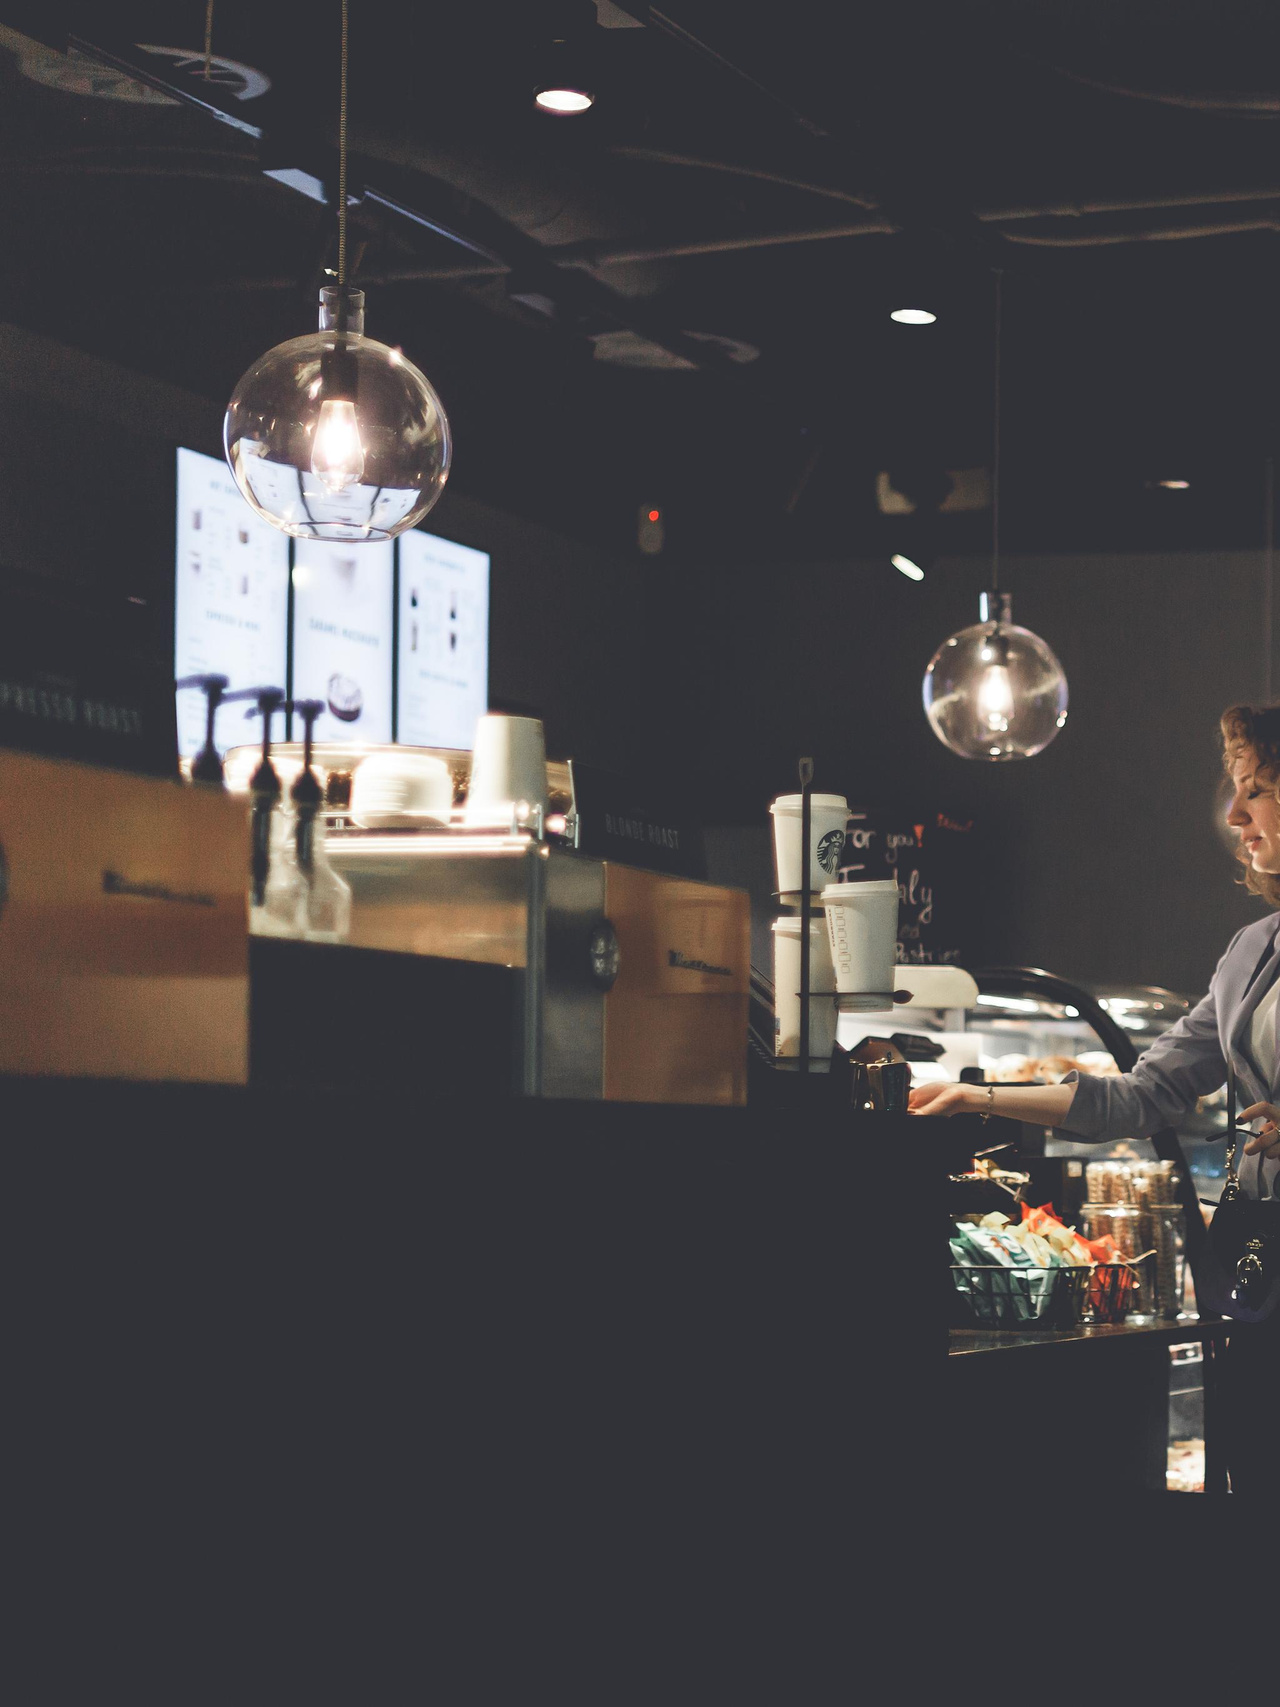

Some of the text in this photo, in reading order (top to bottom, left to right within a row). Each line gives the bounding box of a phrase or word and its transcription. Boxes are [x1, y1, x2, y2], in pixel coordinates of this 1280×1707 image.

[83, 698, 142, 737] ROAST
[605, 812, 679, 851] BLONDE ROAST
